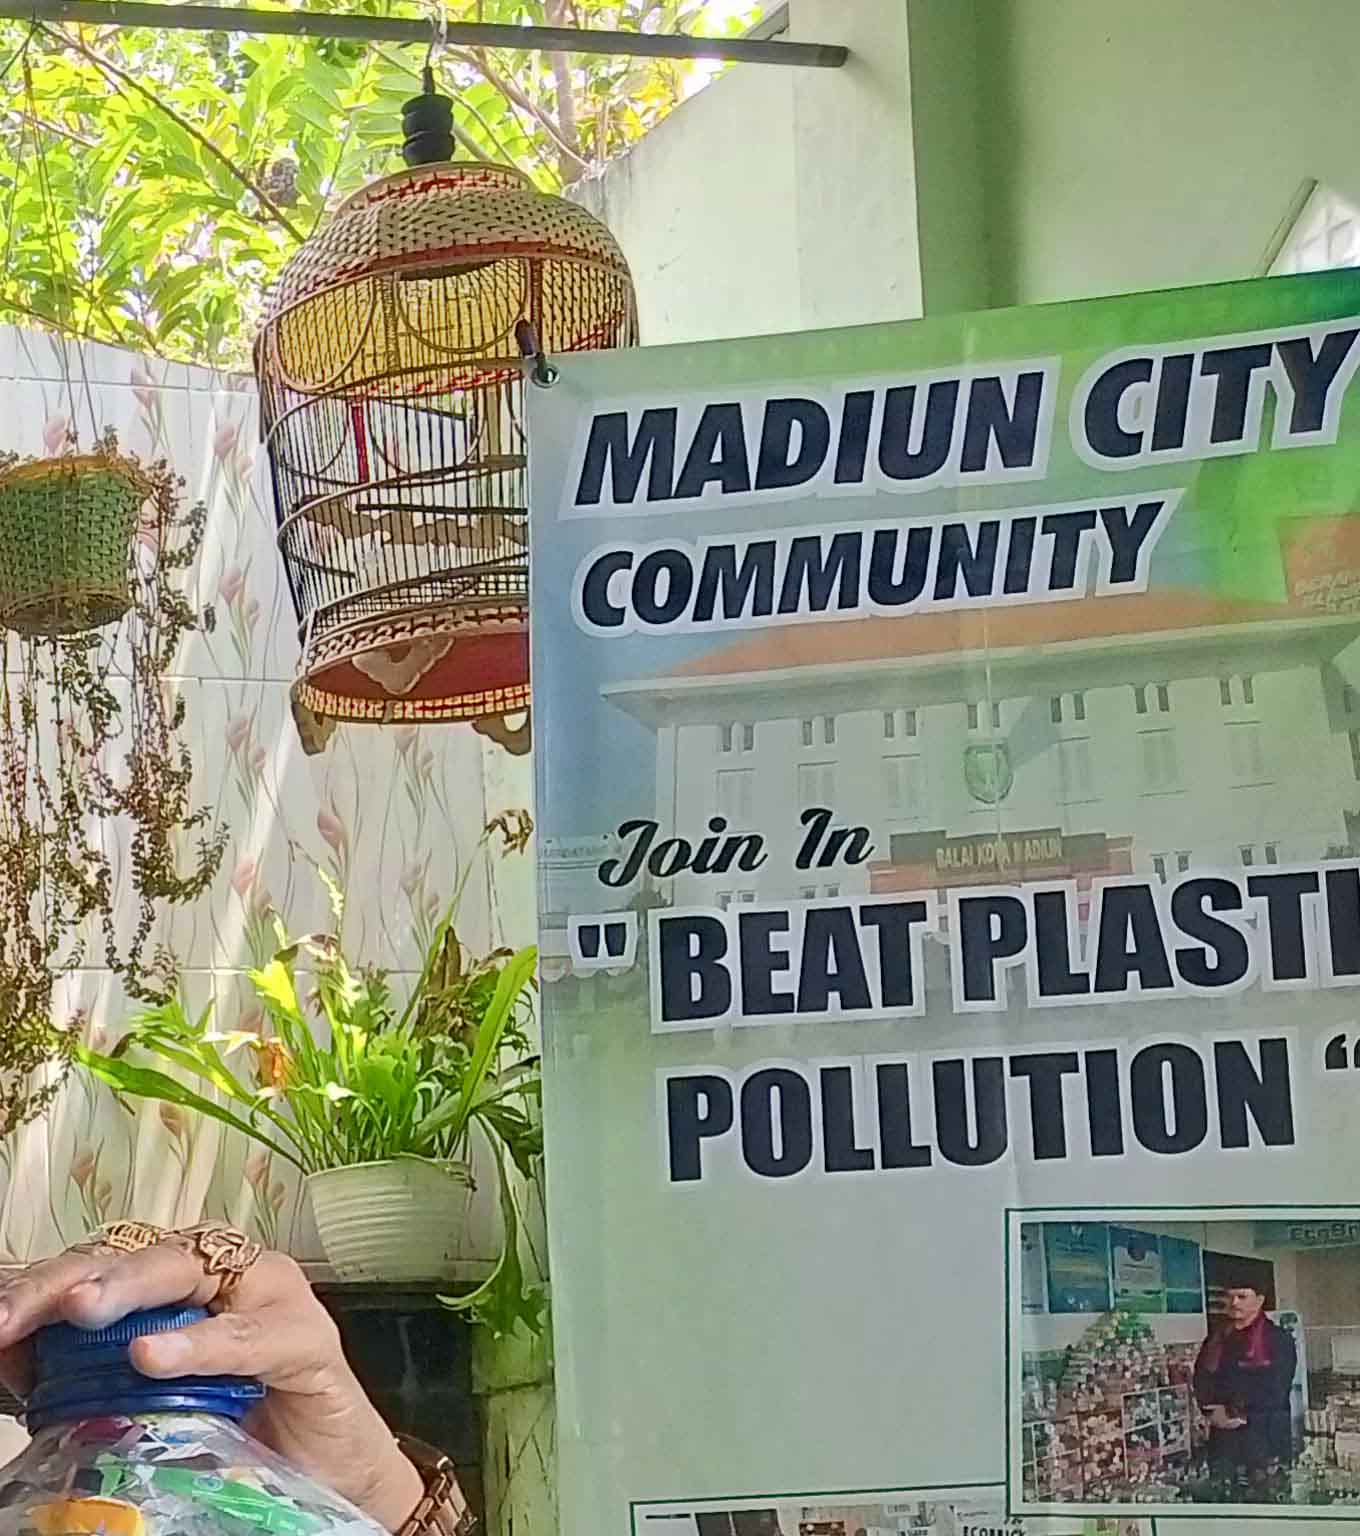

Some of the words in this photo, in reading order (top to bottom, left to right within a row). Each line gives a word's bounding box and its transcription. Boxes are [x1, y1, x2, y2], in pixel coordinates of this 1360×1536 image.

[575, 371, 1045, 507] MADIUN
[1082, 326, 1360, 460] CITY
[581, 500, 1167, 629] COMMUNITY
[597, 816, 768, 890] Join
[794, 806, 876, 874] In
[657, 900, 927, 1024] BEAT
[667, 1035, 1296, 1184] POLLUTION
